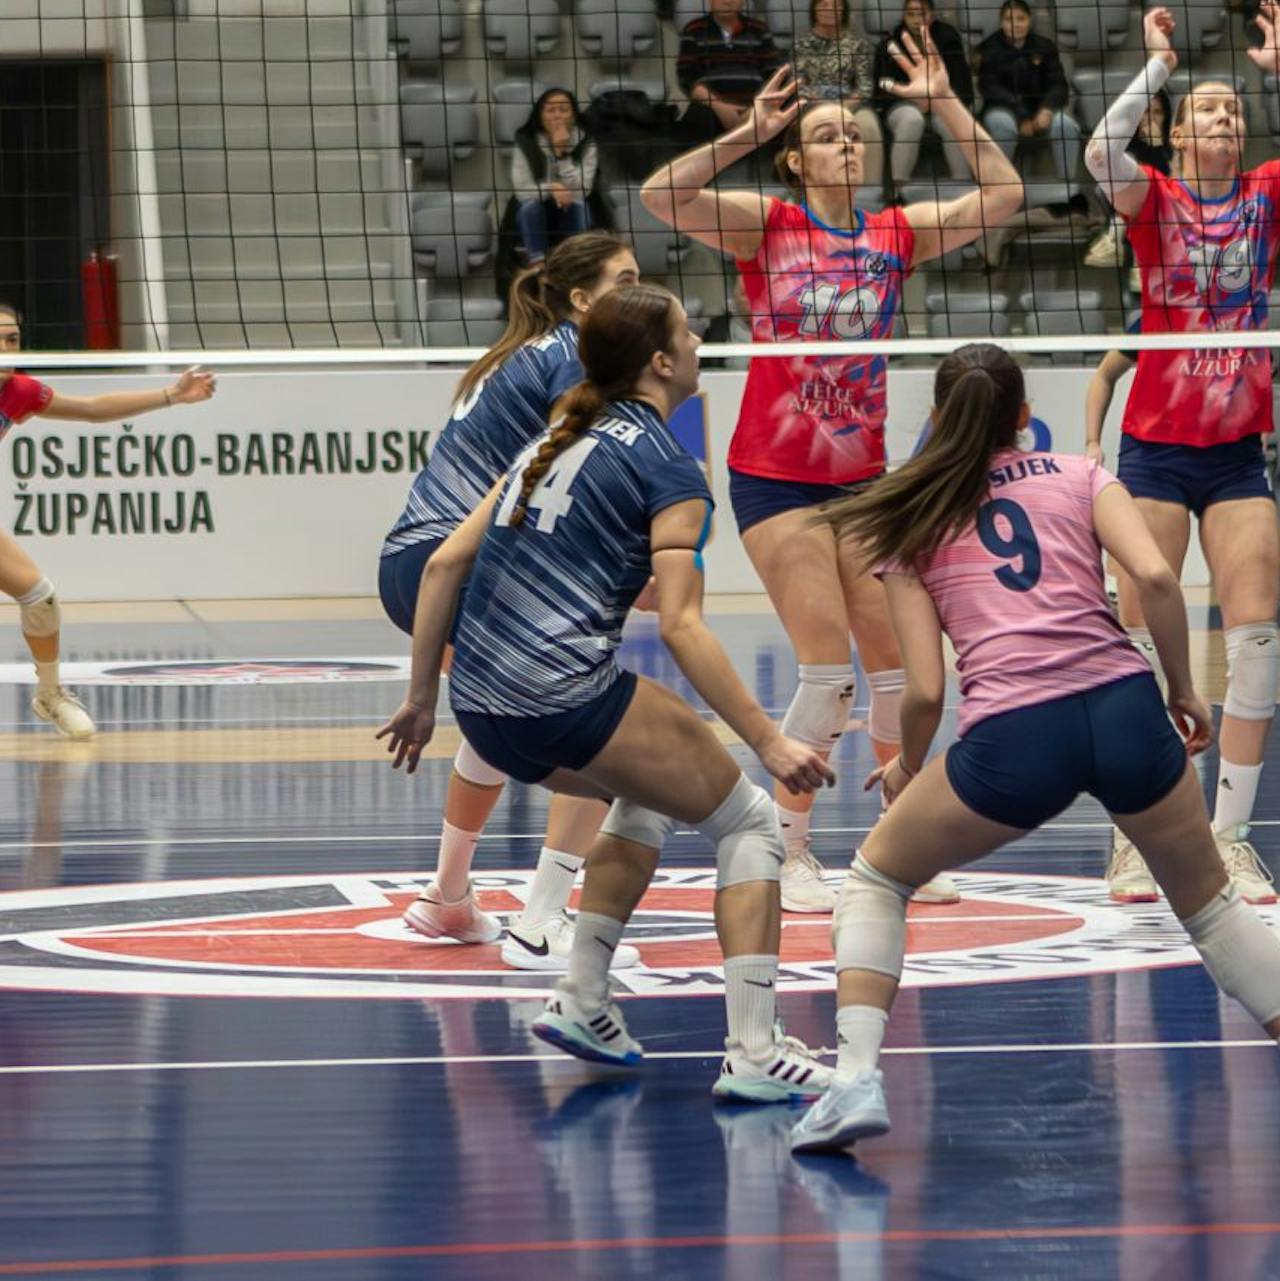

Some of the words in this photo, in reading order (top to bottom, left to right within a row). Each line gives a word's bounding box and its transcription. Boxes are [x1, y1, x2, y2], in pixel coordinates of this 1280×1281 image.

[1187, 239, 1254, 294] 19
[798, 282, 881, 341] 10
[12, 423, 431, 479] OSJEČKO-BARANJSK
[988, 458, 1062, 488] SIJEK
[13, 482, 217, 536] ŽUPANIJA
[495, 433, 600, 534] 14
[976, 497, 1042, 592] 9
